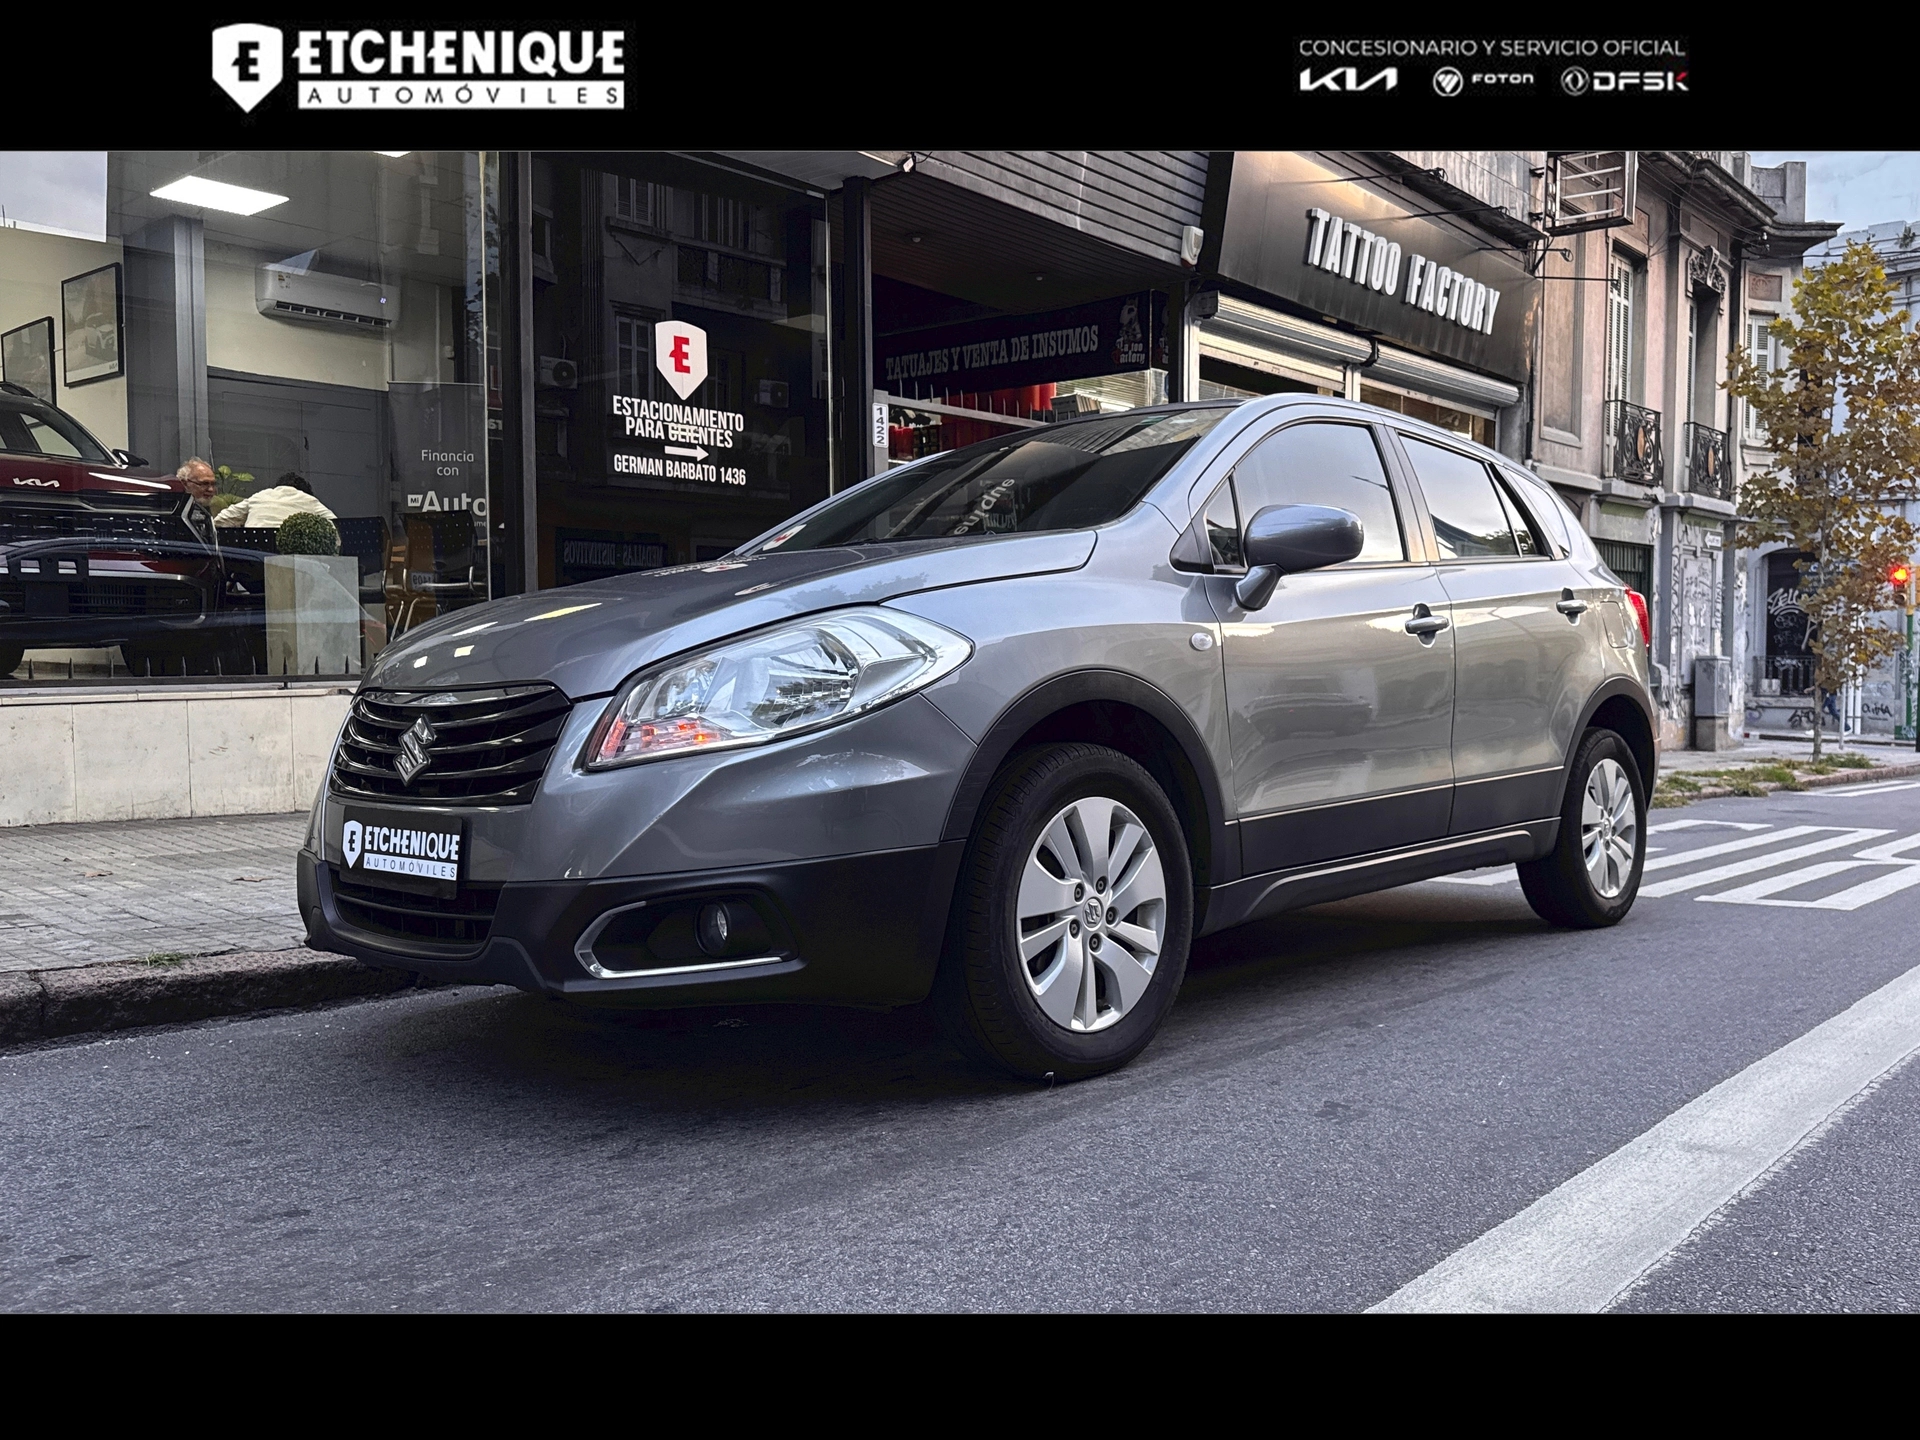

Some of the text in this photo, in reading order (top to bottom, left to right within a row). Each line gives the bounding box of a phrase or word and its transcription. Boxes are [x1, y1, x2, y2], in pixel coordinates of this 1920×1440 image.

[1307, 207, 1500, 336] TATTOO FACTORY
[886, 325, 1099, 380] TATUAJES Y VENTA DE INSUMOS
[613, 395, 744, 432] ESTACIONAMIENTO
[875, 406, 886, 445] 1422
[625, 416, 733, 448] PARA CLIENTES
[421, 449, 475, 463] Financia
[436, 466, 459, 476] con
[614, 453, 746, 486] GERMAN BARBATO 1436
[364, 825, 460, 860] ETCHENIQUE
[366, 857, 455, 878] AUTOMÓVILES
